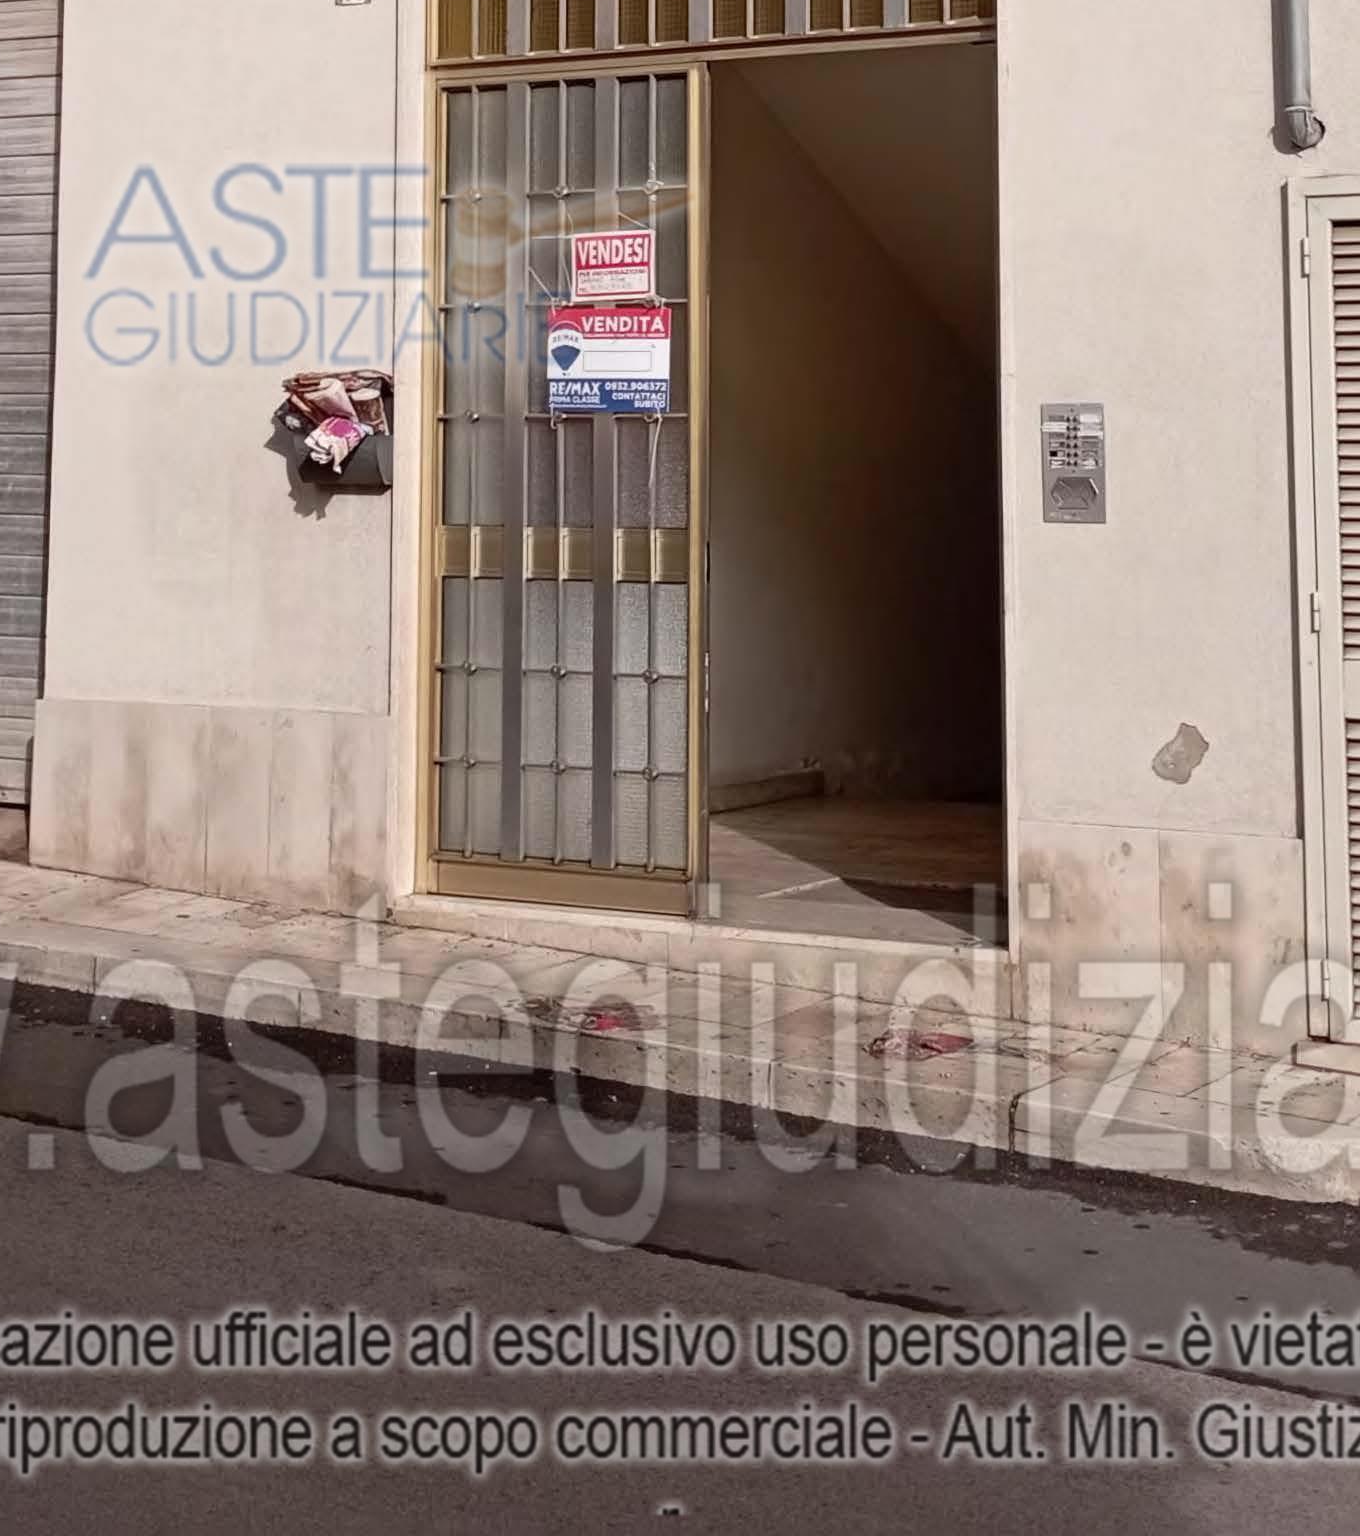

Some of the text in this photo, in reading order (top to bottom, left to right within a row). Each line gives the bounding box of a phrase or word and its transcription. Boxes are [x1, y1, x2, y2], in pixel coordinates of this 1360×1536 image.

[577, 237, 650, 266] VENDESI
[582, 316, 666, 333] VENDITA
[549, 381, 601, 396] RE/MAX
[611, 392, 666, 401] CONTATTACI
